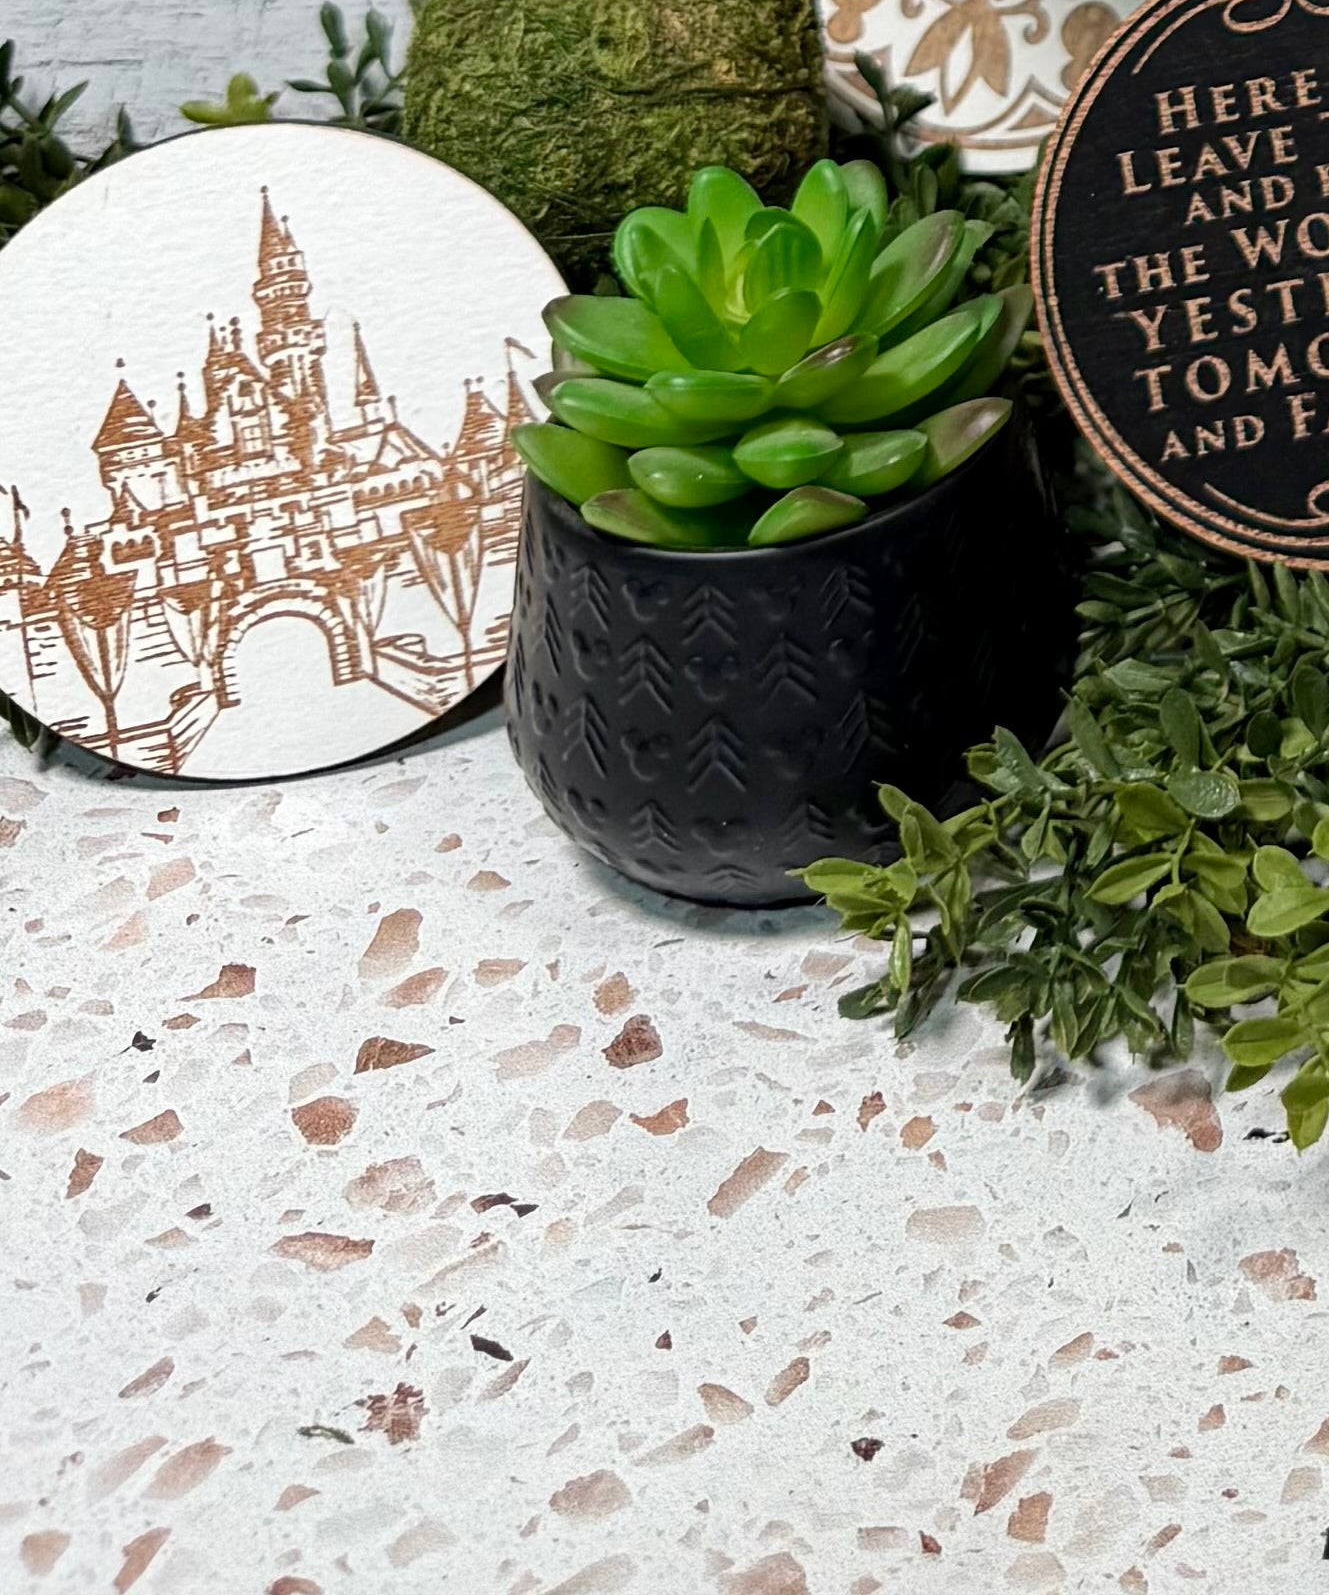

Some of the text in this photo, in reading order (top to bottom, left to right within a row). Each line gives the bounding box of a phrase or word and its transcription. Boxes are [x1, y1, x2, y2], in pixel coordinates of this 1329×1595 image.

[1154, 68, 1323, 136] HERE
[1115, 125, 1299, 196] LEAVE
[1184, 175, 1296, 226] AND
[1093, 244, 1211, 300] THE
[1161, 414, 1266, 463] AND
